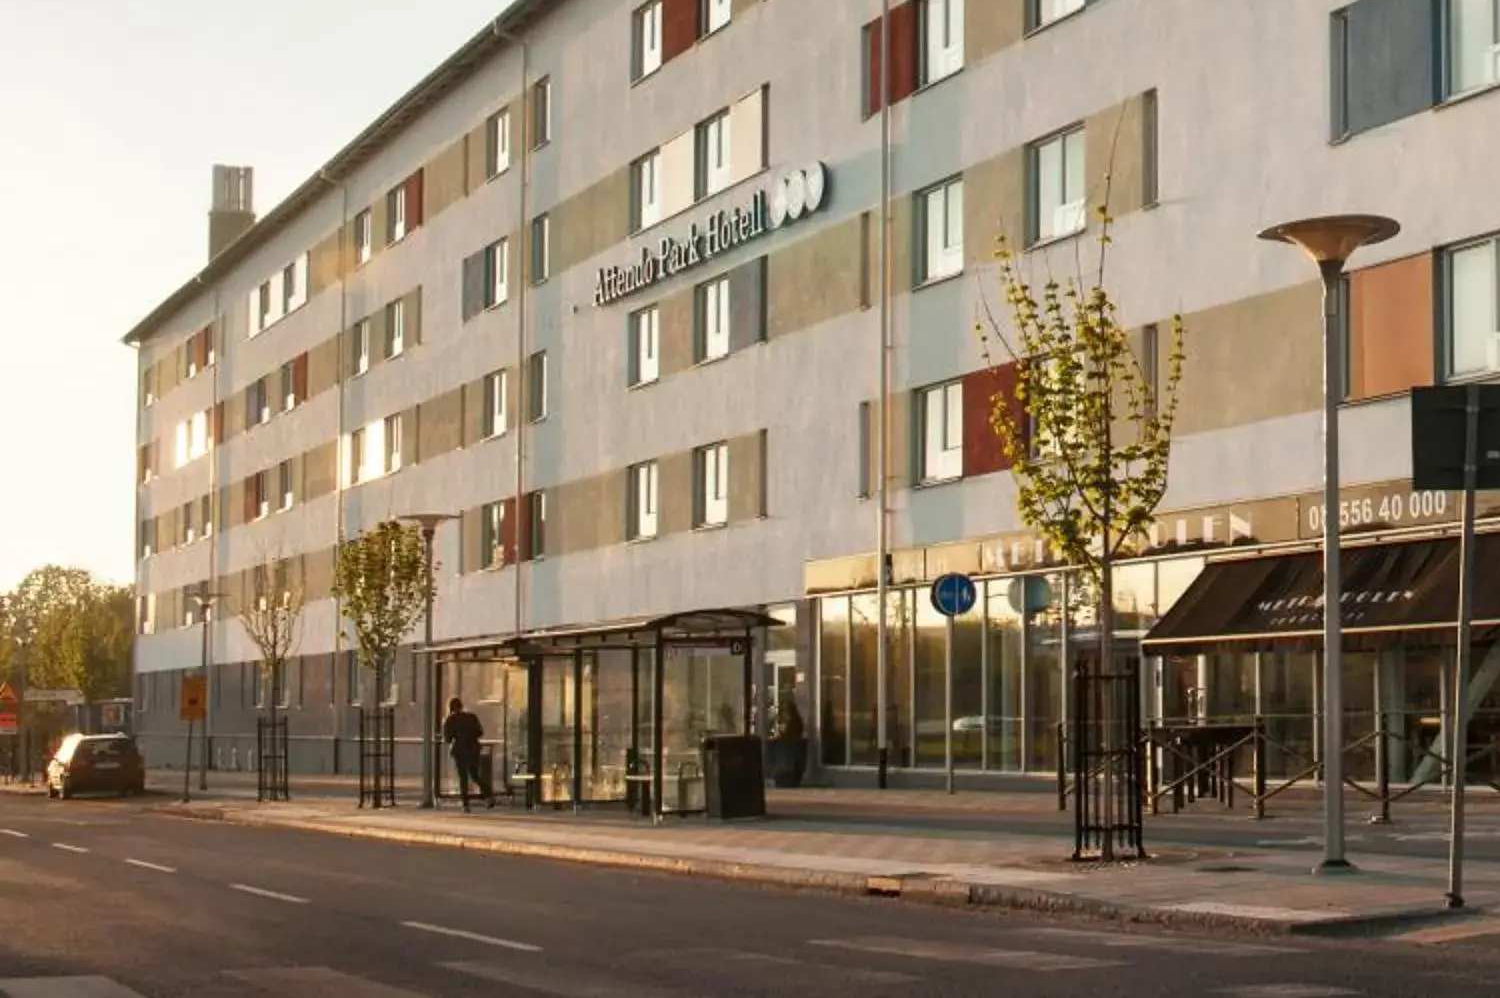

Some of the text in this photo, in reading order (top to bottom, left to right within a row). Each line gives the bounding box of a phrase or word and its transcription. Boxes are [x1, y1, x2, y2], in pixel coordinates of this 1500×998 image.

[592, 188, 769, 307] Attendo Park Hotell
[1379, 493, 1402, 521] 40
[1409, 489, 1446, 519] 000
